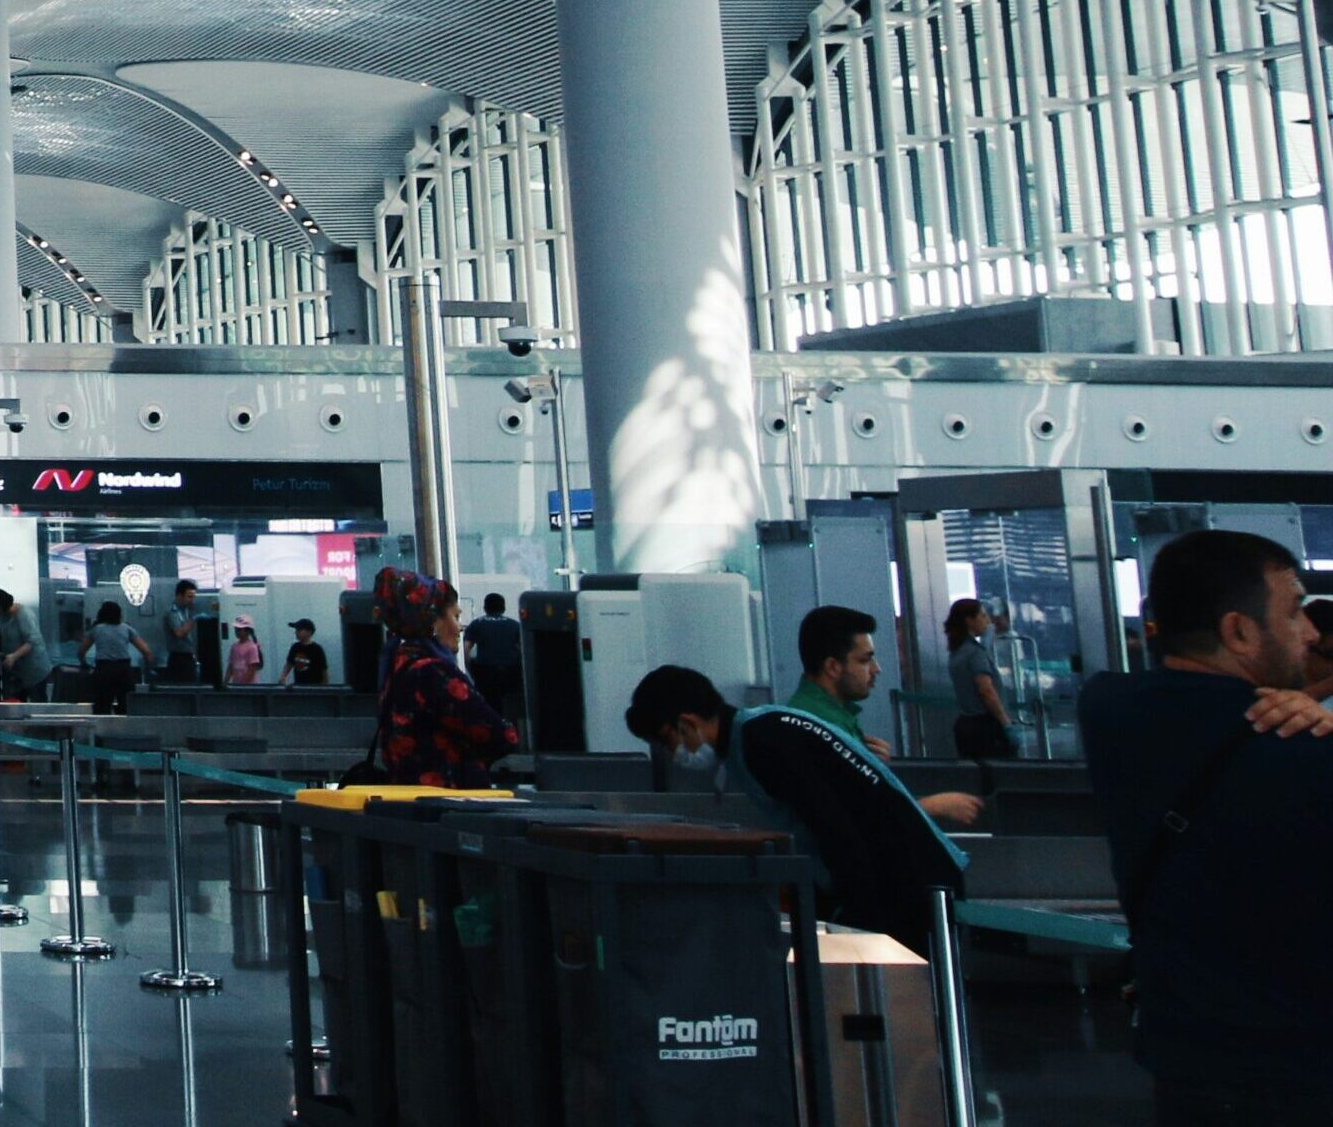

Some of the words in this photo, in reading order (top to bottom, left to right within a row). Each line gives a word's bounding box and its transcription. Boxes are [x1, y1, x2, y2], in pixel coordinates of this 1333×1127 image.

[98, 472, 182, 488] Nordwind
[253, 478, 284, 491] Petur
[289, 477, 331, 491] Turizm
[99, 487, 123, 496] Airlines
